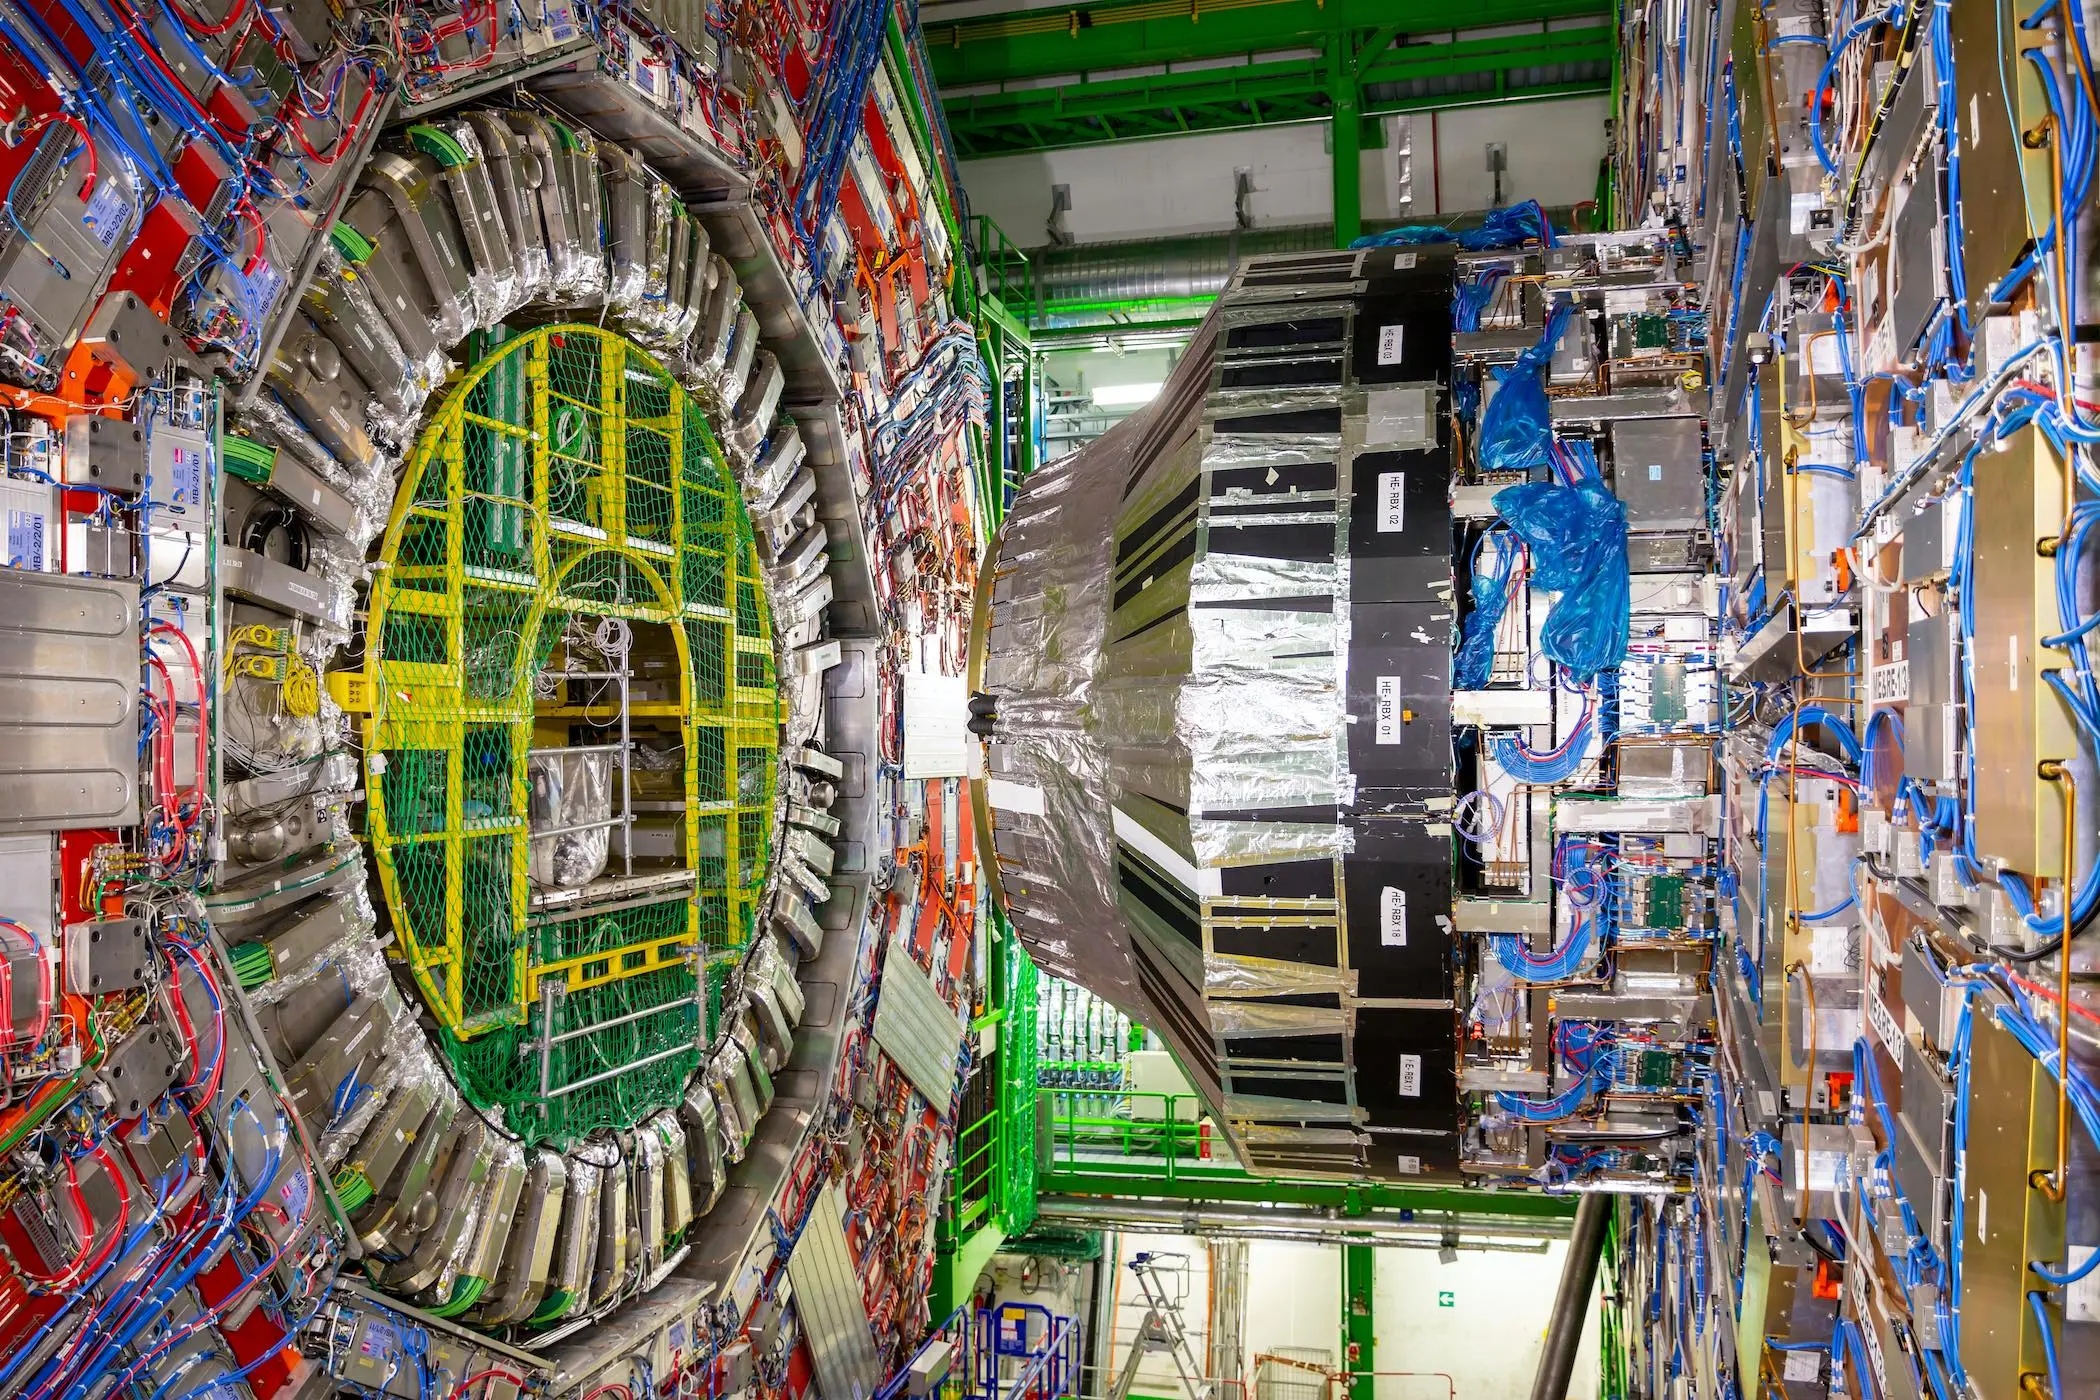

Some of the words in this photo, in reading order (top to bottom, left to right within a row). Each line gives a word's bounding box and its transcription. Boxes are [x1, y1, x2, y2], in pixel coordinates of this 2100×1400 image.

[101, 203, 129, 247] MB/-2/2/02
[192, 454, 200, 505] MB/-2/1/01
[1390, 476, 1400, 490] HE-
[1390, 492, 1400, 510] RBX
[1389, 515, 1399, 525] 02
[1381, 681, 1391, 697] HE-
[1381, 700, 1391, 720] RBX
[1381, 725, 1391, 735] 01
[1391, 891, 1401, 906] HE-
[1391, 908, 1401, 926] RBX
[1391, 929, 1401, 938] 18
